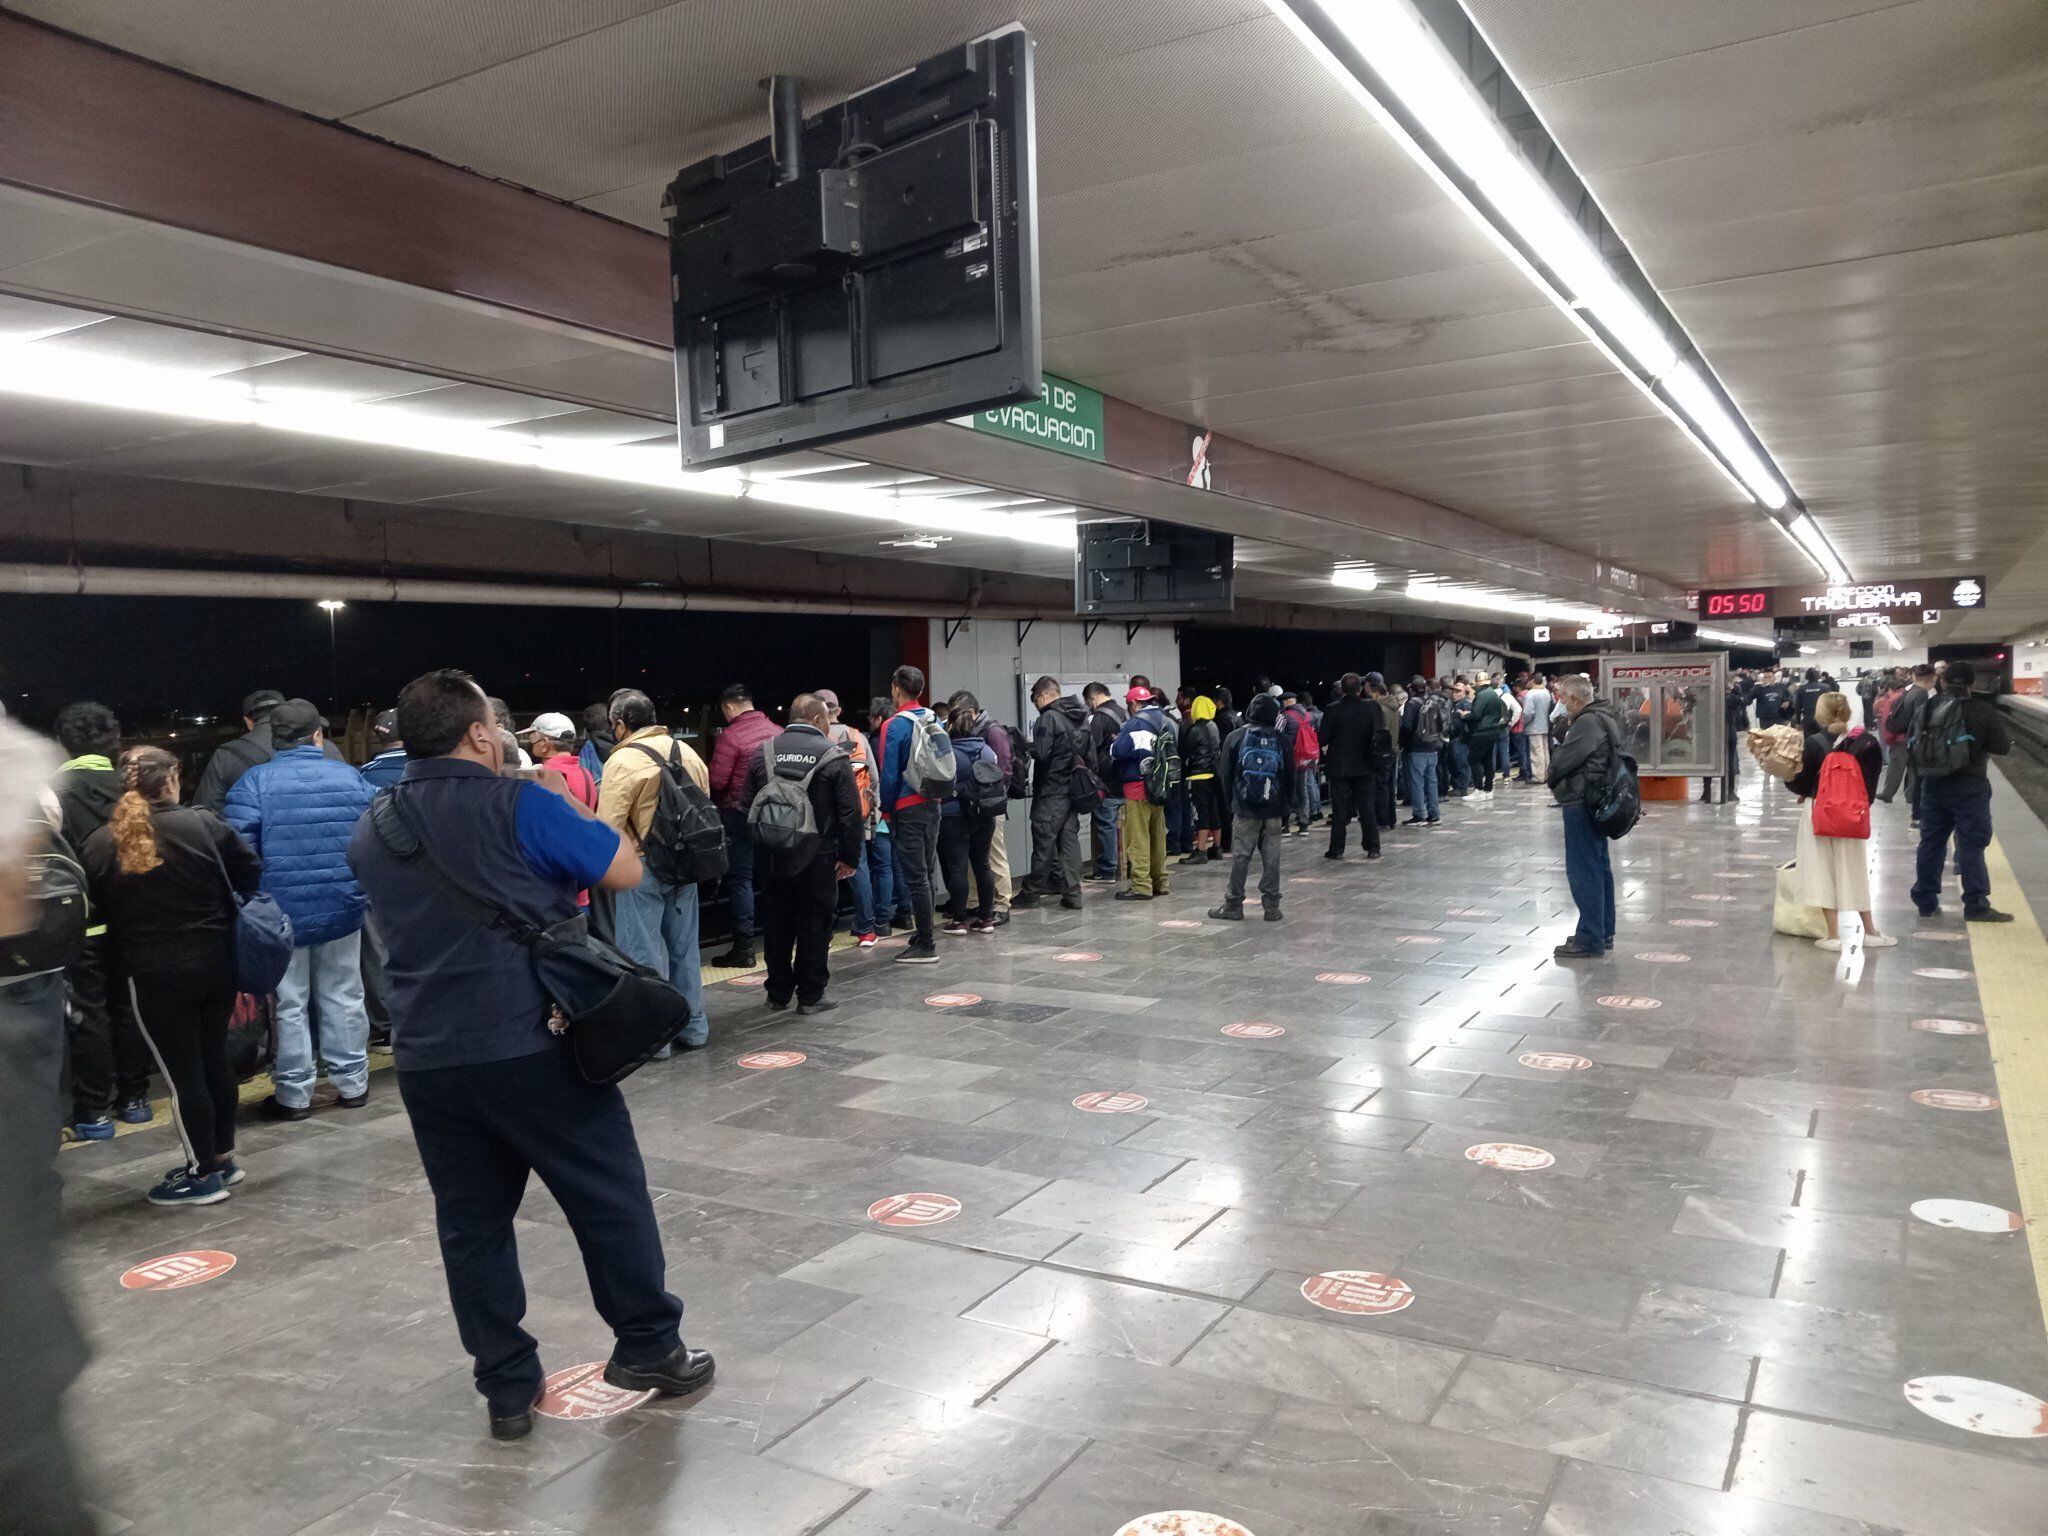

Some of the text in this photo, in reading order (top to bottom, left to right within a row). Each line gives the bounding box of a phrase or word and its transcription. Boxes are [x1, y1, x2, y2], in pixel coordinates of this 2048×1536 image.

[1054, 386, 1076, 413] DE
[985, 407, 1095, 450] EVACUACION
[1708, 594, 1735, 615] 05
[1739, 593, 1765, 613] 50
[1800, 592, 1922, 612] TACUBAYA
[1837, 616, 1891, 628] SALIDA
[775, 753, 817, 764] GURIDAD
